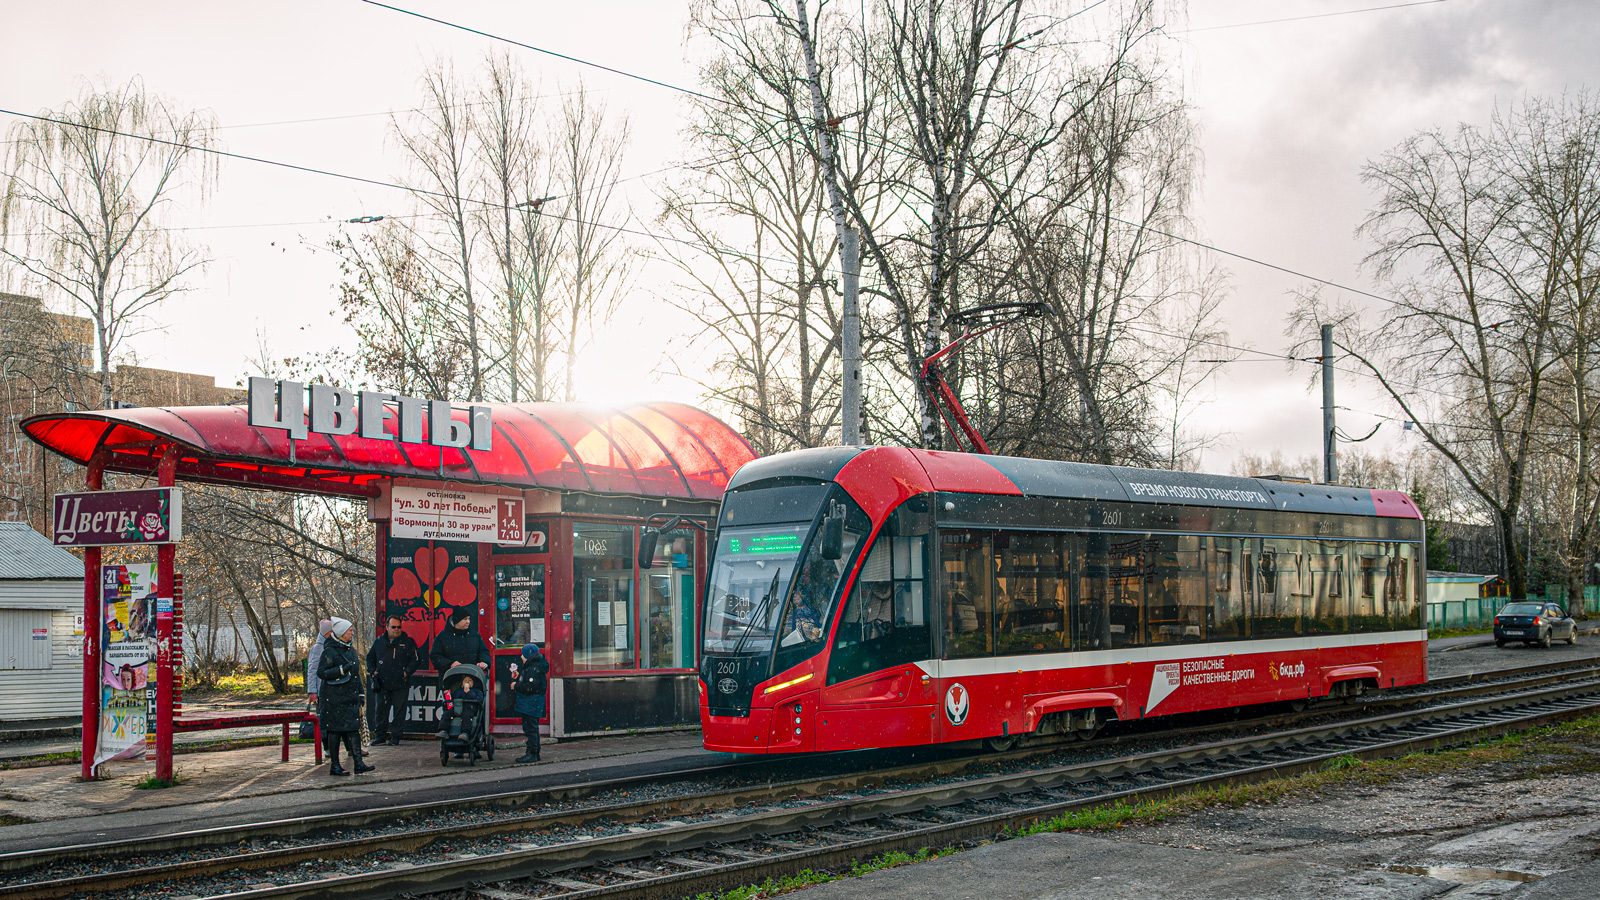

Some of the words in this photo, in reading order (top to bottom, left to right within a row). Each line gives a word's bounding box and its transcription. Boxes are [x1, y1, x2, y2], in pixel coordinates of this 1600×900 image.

[248, 376, 492, 452] ЦВЕТЫ
[427, 491, 466, 500] остановка
[1129, 482, 1169, 497] ВРЕМЯ
[1166, 485, 1207, 500] НОВОГО
[1204, 487, 1268, 504] ТРАНСПОРТА
[417, 499, 430, 509] 30
[433, 502, 451, 511] лет
[504, 501, 516, 517] Т
[56, 497, 138, 544] Цветы
[1102, 511, 1123, 525] 2601
[447, 520, 458, 529] 30
[459, 523, 470, 531] ар
[501, 530, 520, 540] 7,10
[390, 556, 413, 564] ГВОЗДИКА
[454, 555, 470, 563] РОЗЫ
[107, 569, 117, 584] 21
[717, 661, 740, 675] 2601
[1182, 659, 1225, 673] БЕЗОПАСНЫЕ
[1279, 660, 1305, 677] бкд.рф
[1182, 671, 1231, 686] КАЧЕСТВЕННЫЕ
[1231, 669, 1255, 683] ДОРОГИ
